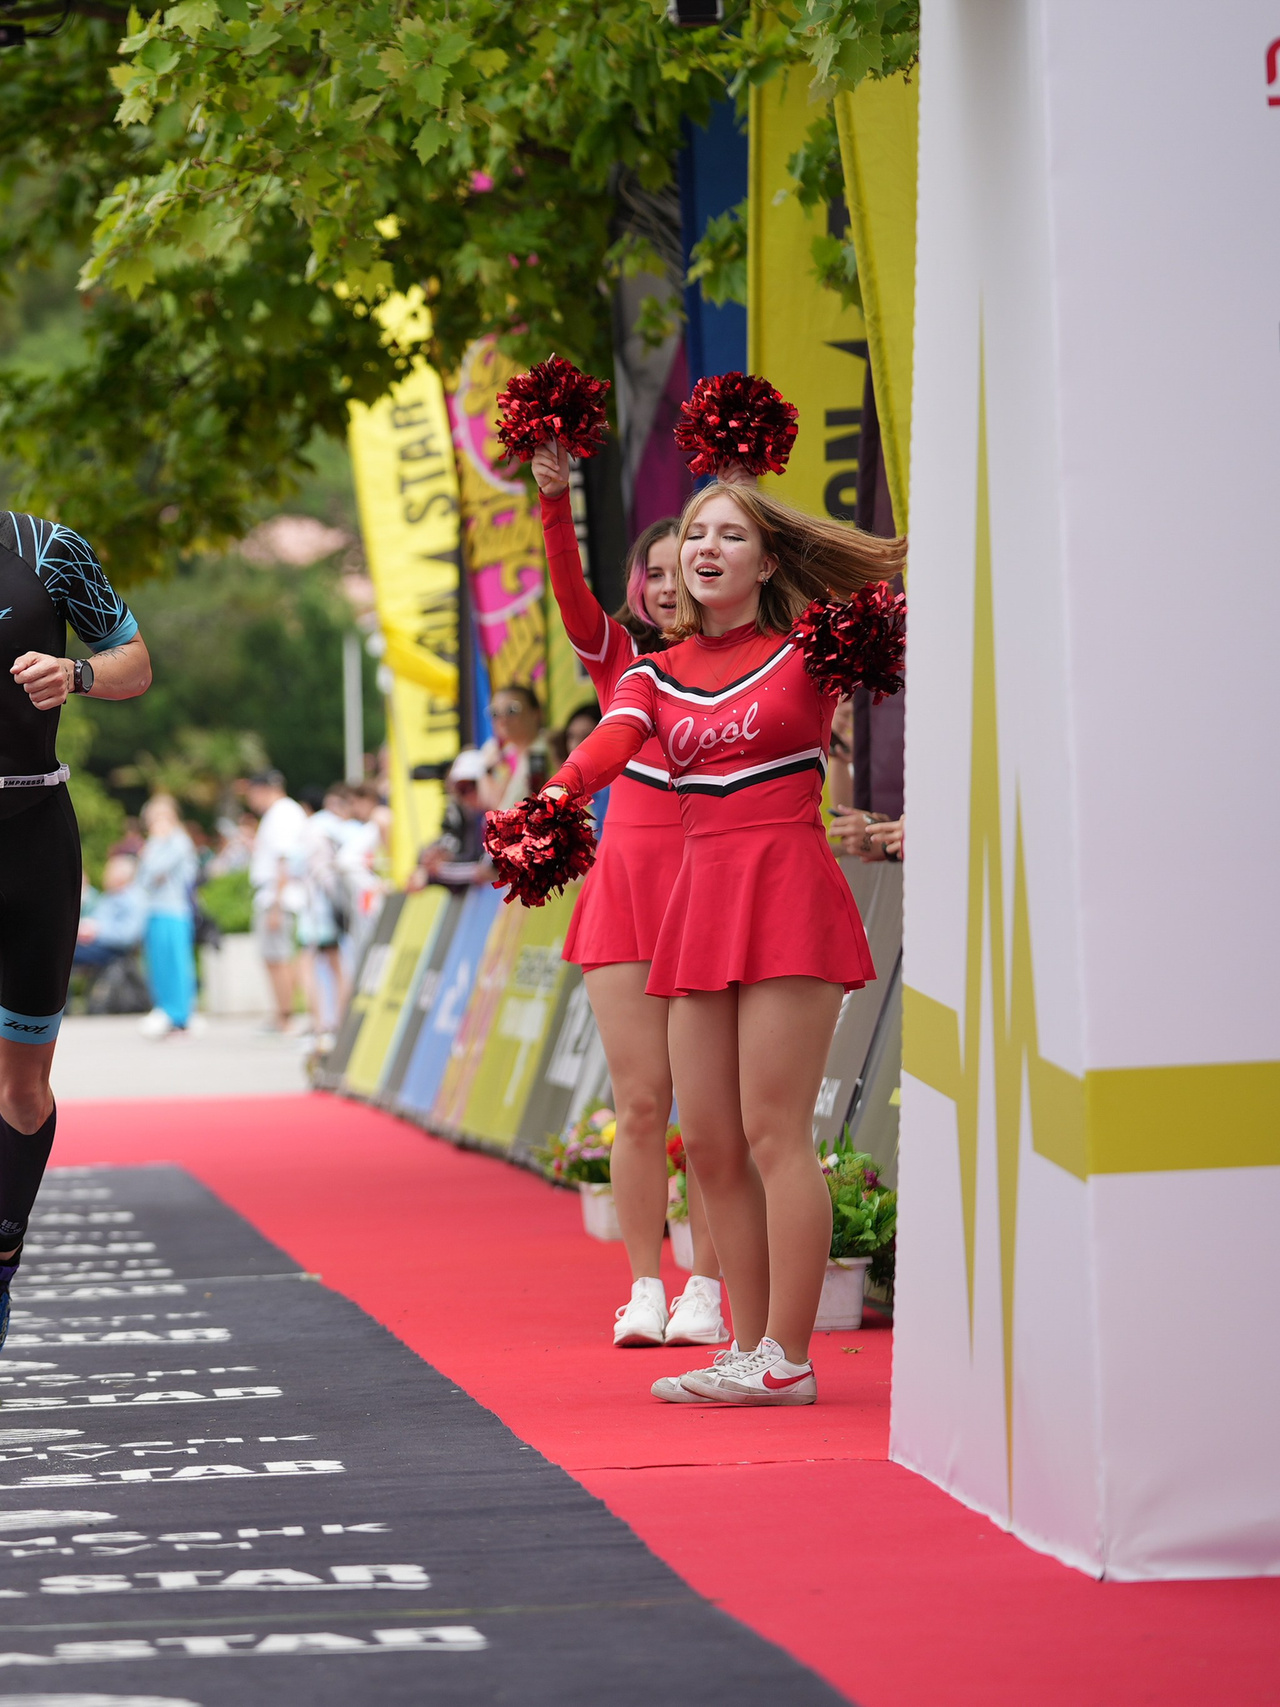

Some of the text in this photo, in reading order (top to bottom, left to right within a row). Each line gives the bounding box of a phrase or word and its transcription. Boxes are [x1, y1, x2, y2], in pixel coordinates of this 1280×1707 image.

[667, 701, 761, 767] Cool
[0, 1386, 285, 1408] STAR
[19, 1459, 345, 1483] STAR
[39, 1563, 432, 1594] STAR
[53, 1625, 489, 1657] STAR
